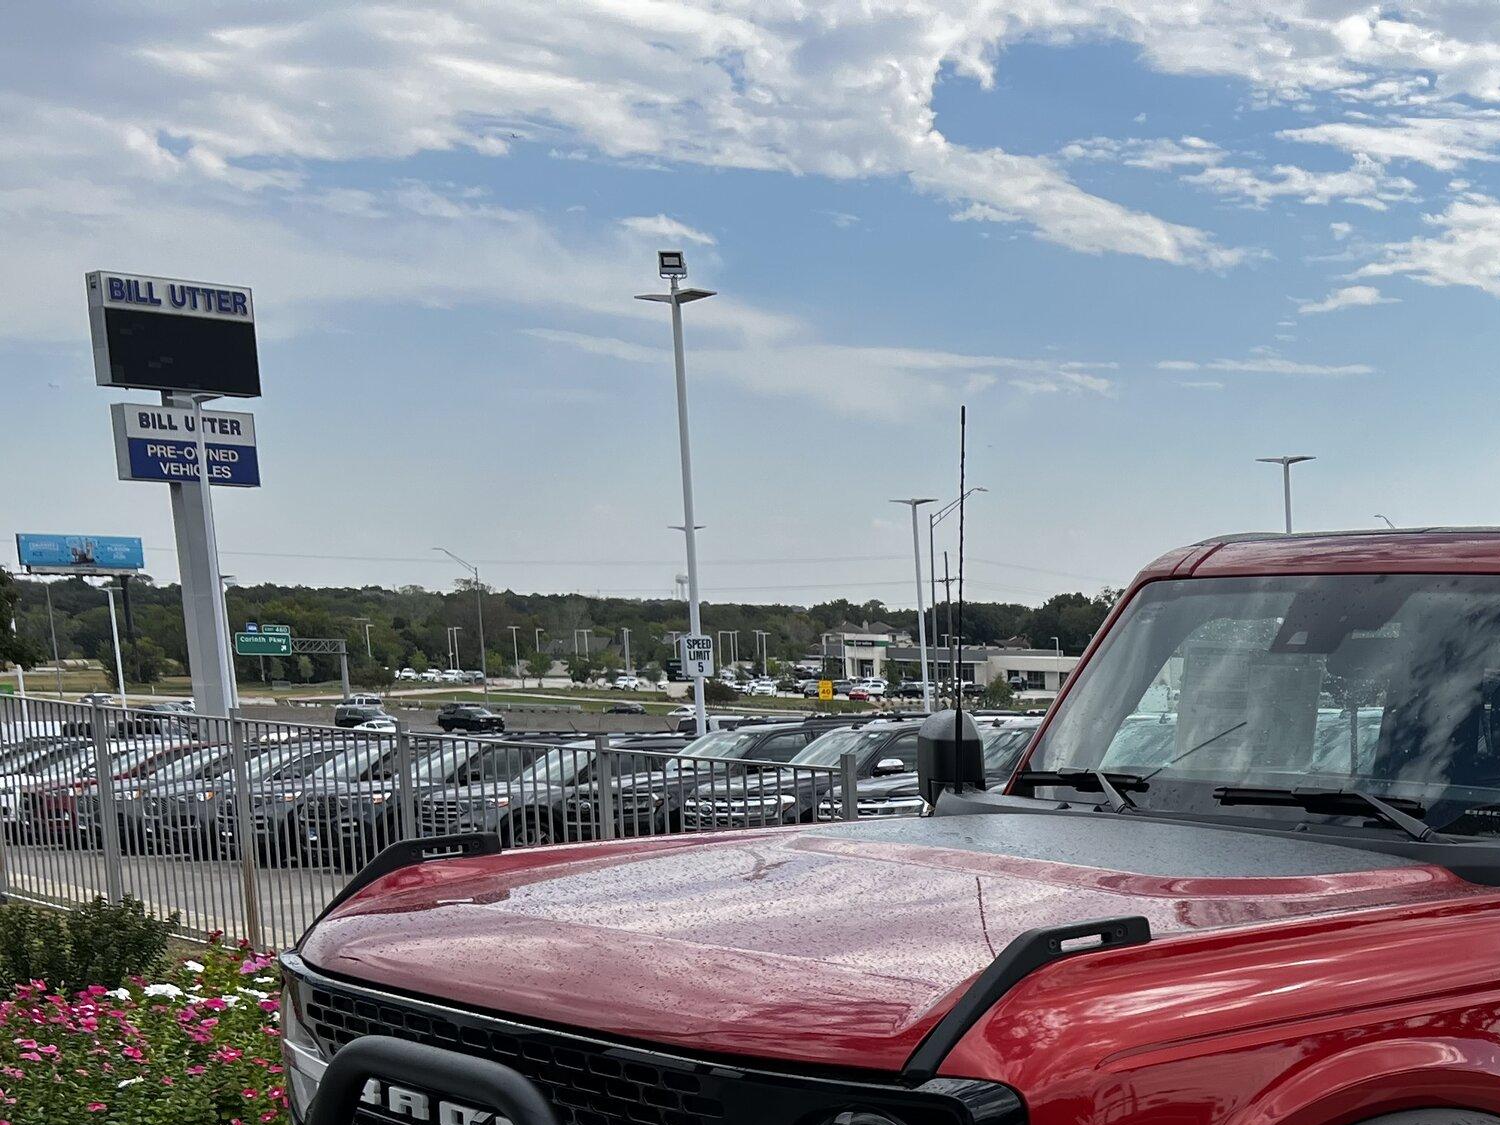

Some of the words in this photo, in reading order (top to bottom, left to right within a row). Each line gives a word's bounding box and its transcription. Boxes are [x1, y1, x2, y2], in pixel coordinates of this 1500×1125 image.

[108, 277, 162, 306] BILL
[168, 283, 248, 315] UTTER
[138, 411, 178, 431] BILL
[686, 638, 712, 650] SPEED
[688, 650, 711, 661] LIMIT
[697, 661, 705, 673] 5
[820, 688, 831, 696] 40
